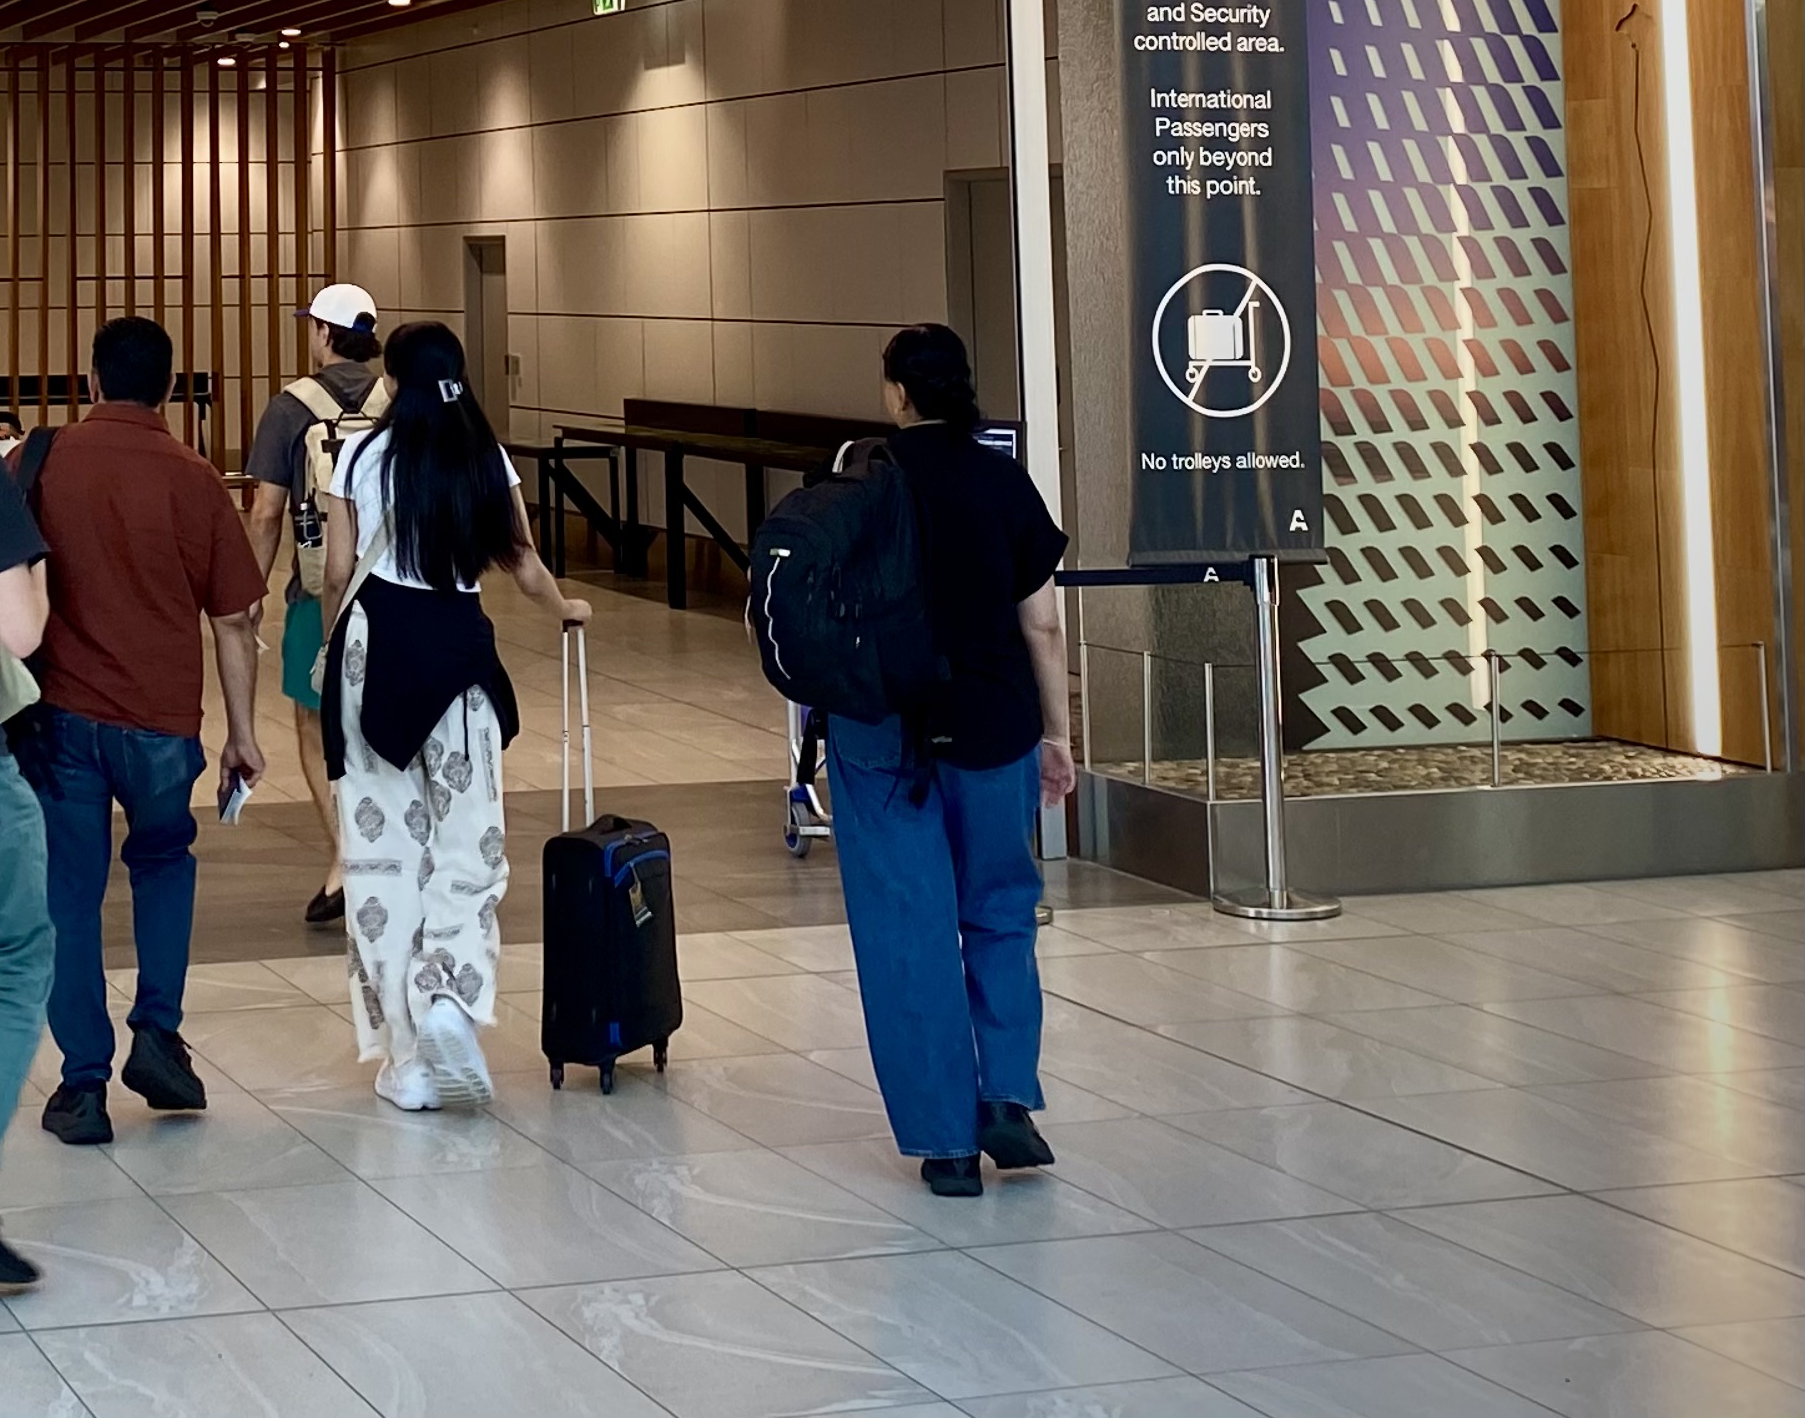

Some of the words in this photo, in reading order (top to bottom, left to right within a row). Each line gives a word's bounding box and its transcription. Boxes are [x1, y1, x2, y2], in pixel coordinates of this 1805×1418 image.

[1146, 1, 1185, 22] and
[1190, 1, 1271, 27] Security
[1140, 451, 1167, 470] No
[1170, 451, 1232, 473] trolleys
[1235, 450, 1306, 468] allowed.
